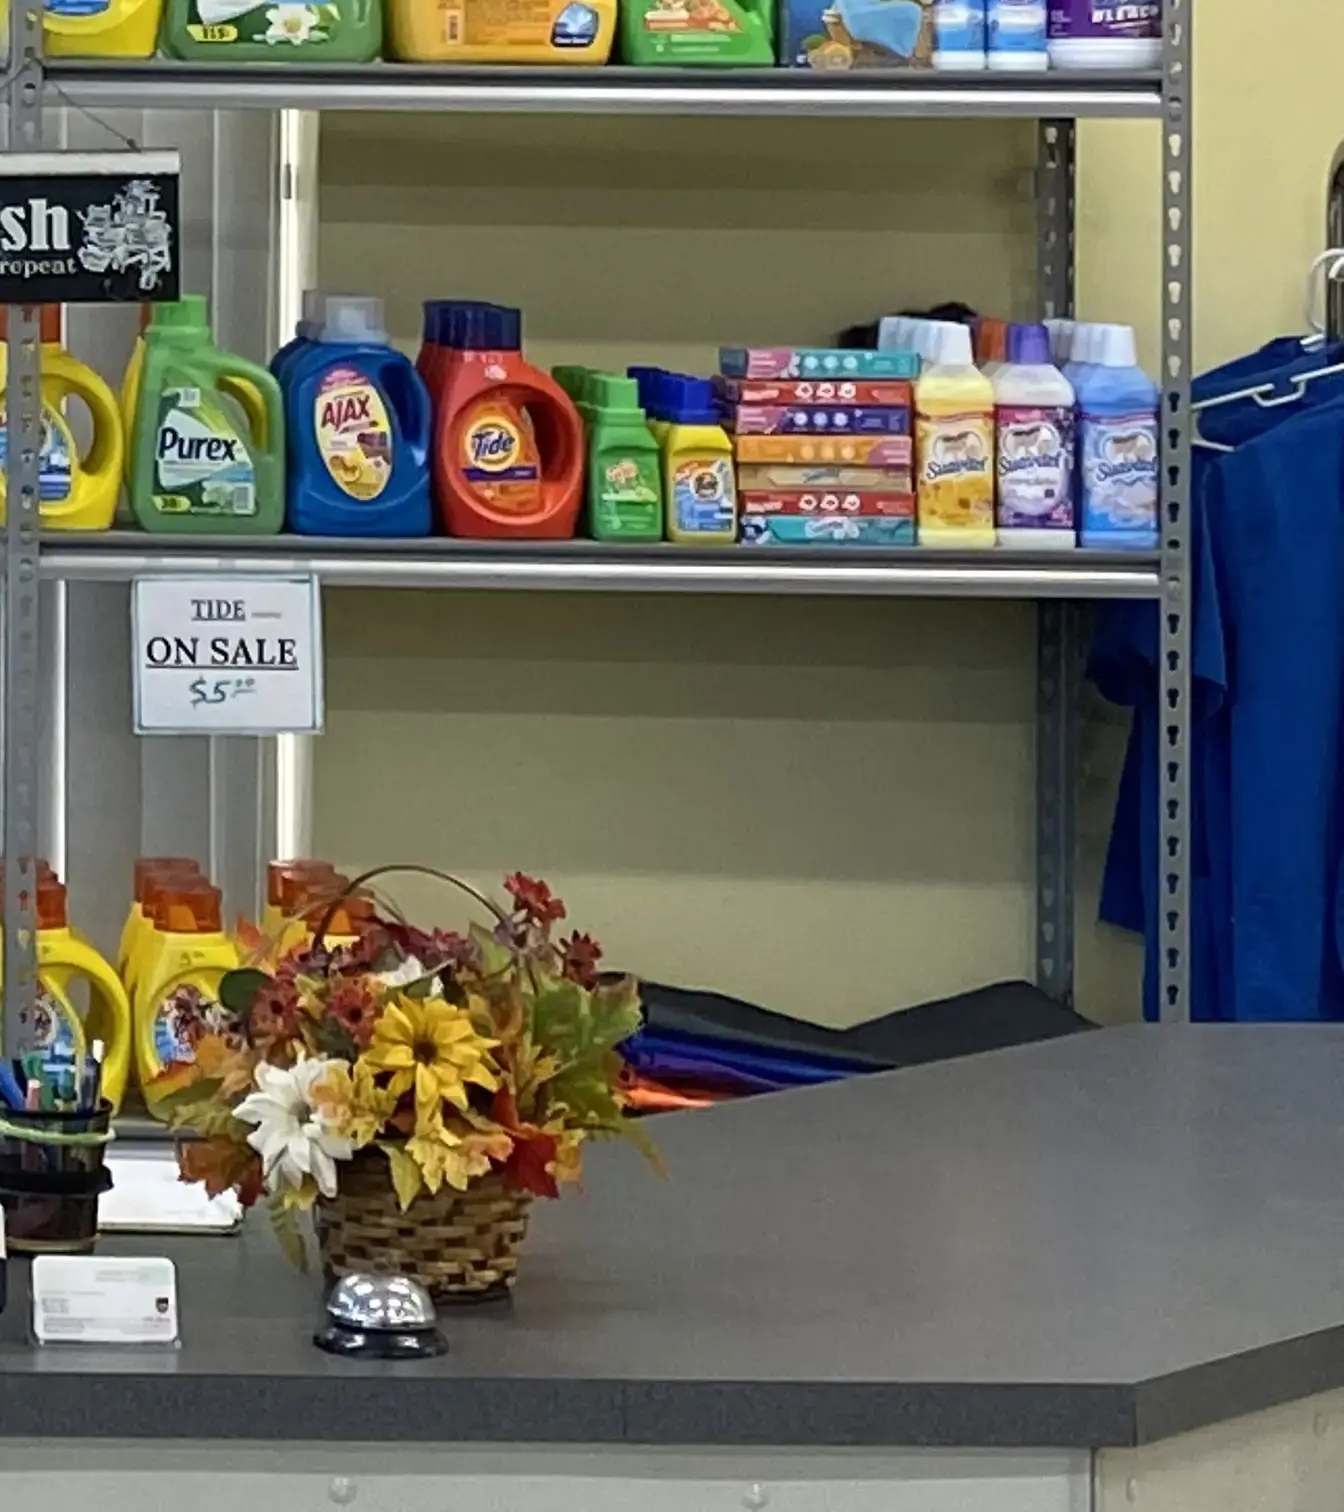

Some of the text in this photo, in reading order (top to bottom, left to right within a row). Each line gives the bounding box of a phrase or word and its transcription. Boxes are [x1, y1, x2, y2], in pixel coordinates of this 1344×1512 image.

[321, 394, 371, 429] AJAX
[158, 426, 238, 462] Purex
[470, 430, 516, 460] Tide
[190, 599, 246, 621] TIDE
[146, 636, 299, 666] ON SALE
